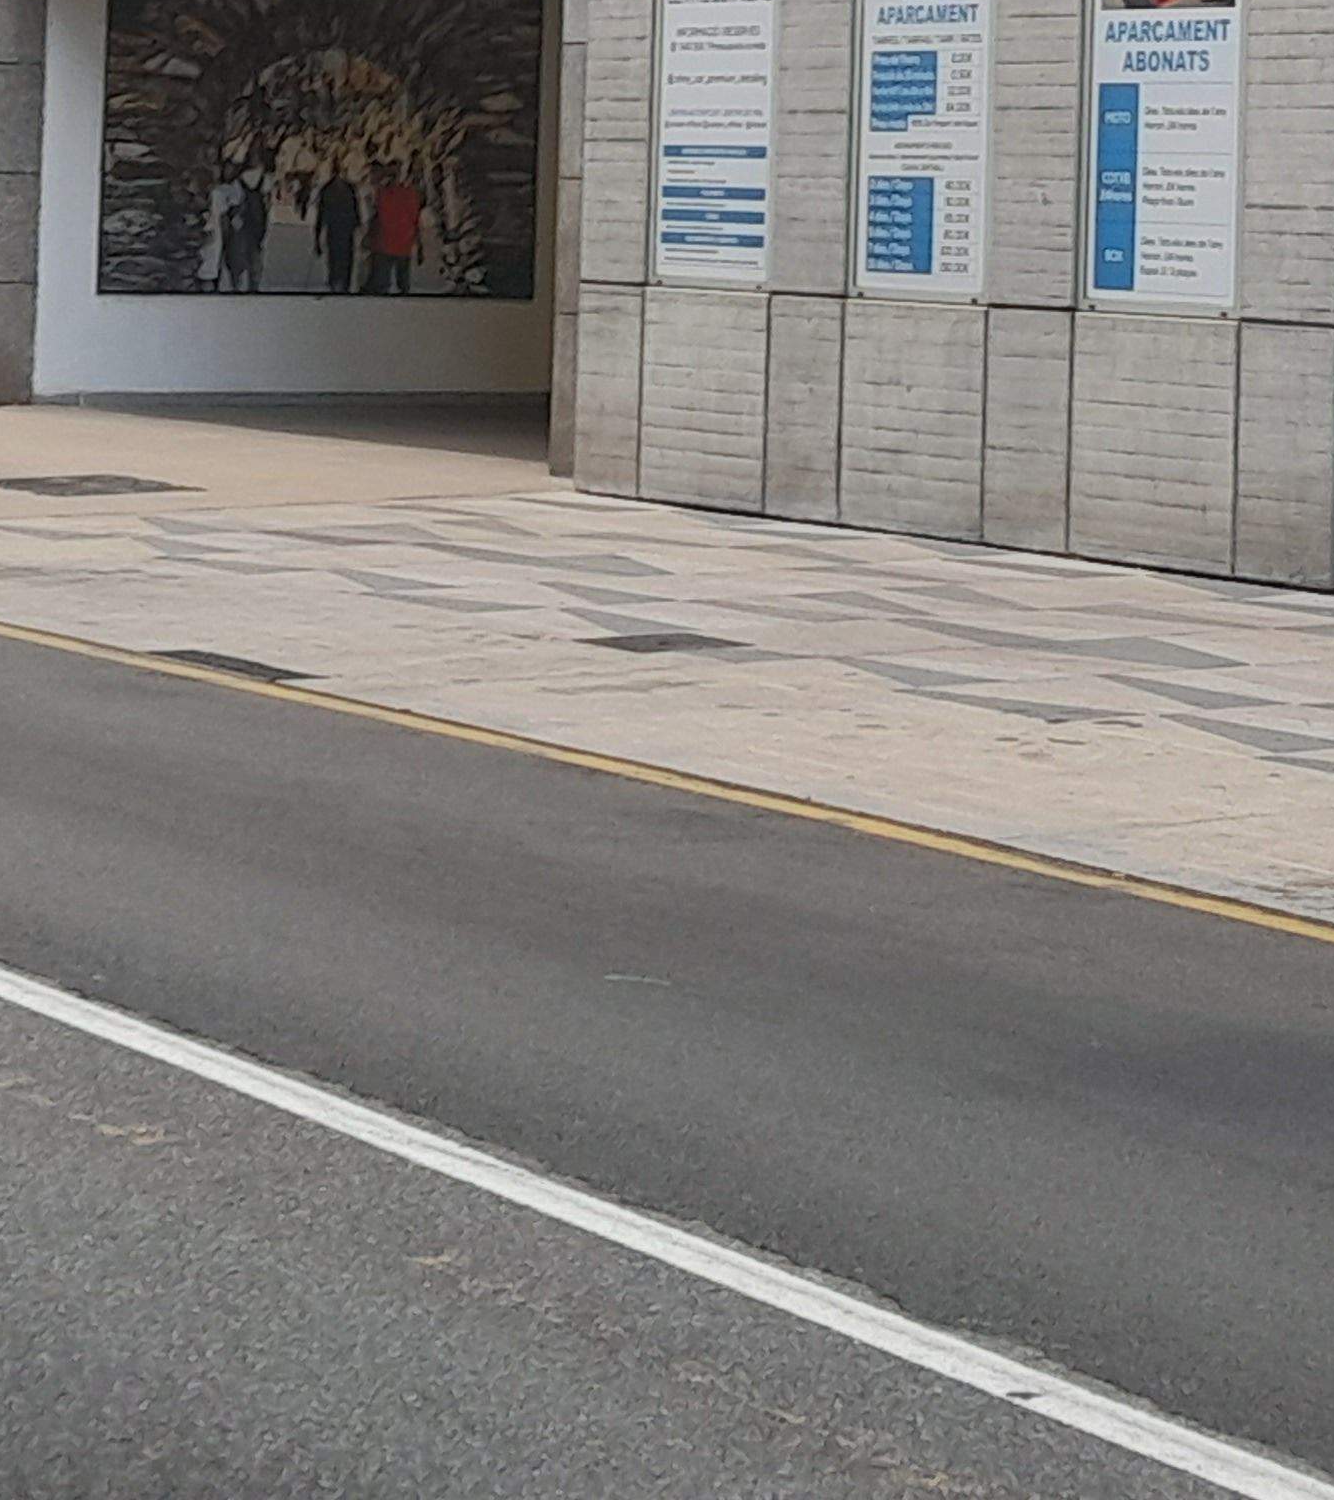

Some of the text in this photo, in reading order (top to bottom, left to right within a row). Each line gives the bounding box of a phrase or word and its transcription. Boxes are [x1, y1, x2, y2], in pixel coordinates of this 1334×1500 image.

[876, 3, 979, 25] APARCAMENT
[1105, 19, 1231, 43] APARCAMENT
[1122, 50, 1210, 72] ABONATS
